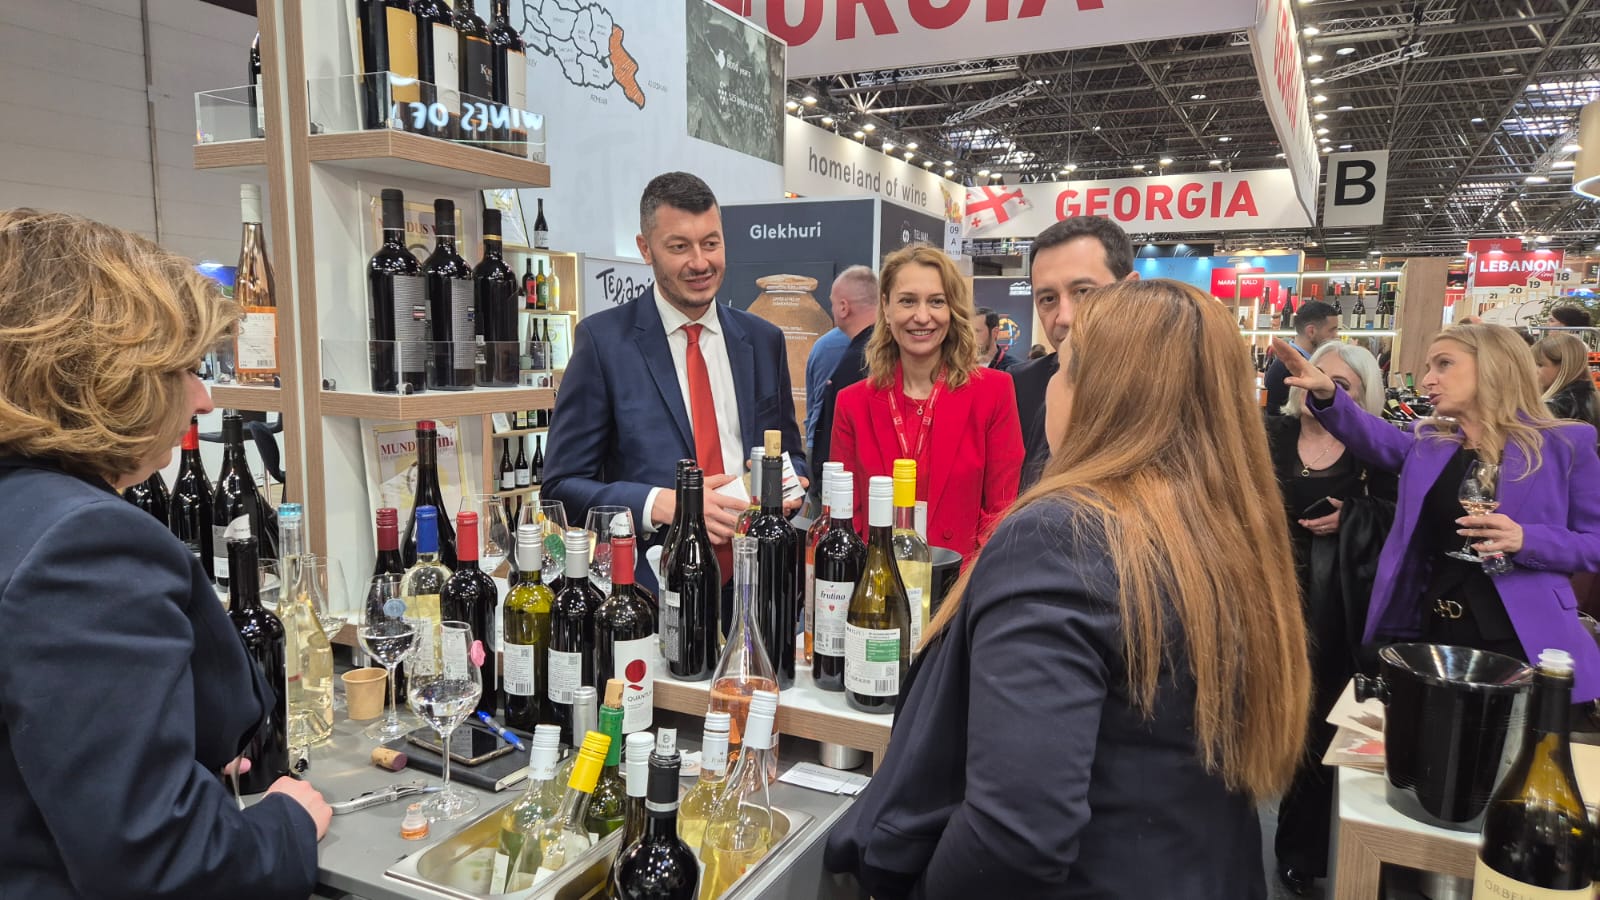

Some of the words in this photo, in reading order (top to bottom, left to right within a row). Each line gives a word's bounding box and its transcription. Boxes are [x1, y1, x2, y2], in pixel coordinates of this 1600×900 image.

[809, 146, 881, 193] homeland
[885, 177, 898, 198] of
[901, 184, 928, 207] wine
[1333, 159, 1377, 206] B
[1055, 180, 1259, 223] GEORGIA
[749, 221, 822, 240] Glekhuri
[949, 225, 959, 234] 09
[950, 238, 957, 246] A
[1479, 259, 1560, 273] LEBANON
[1555, 272, 1570, 281] 18
[1528, 280, 1541, 289] 19
